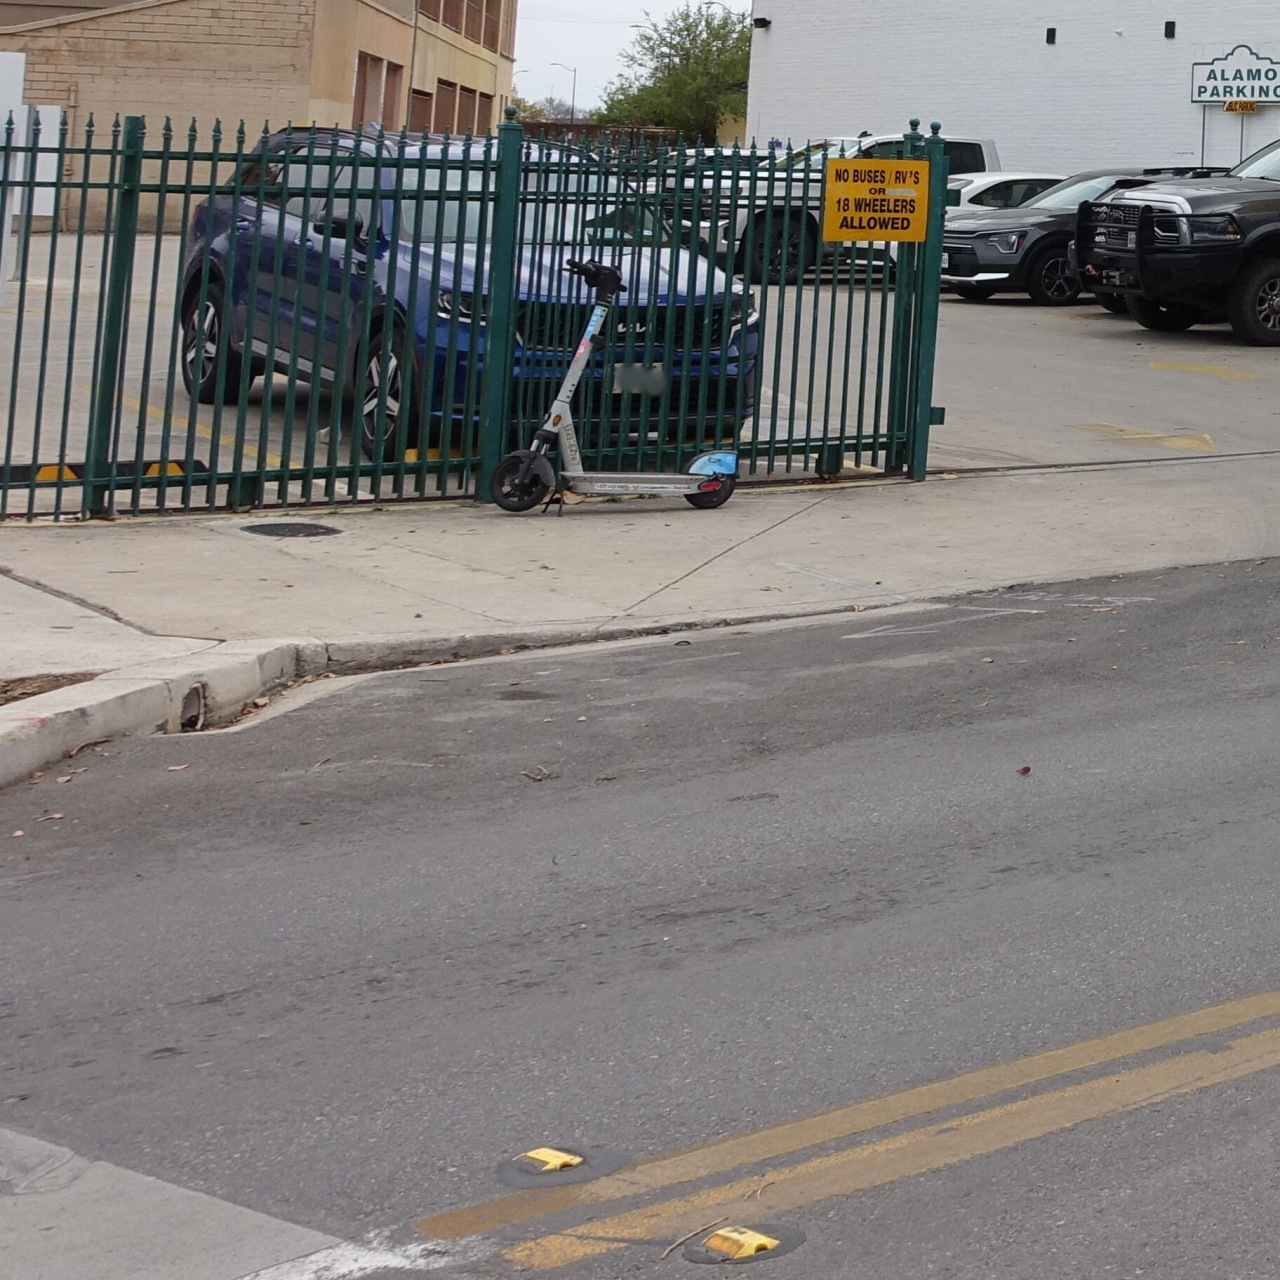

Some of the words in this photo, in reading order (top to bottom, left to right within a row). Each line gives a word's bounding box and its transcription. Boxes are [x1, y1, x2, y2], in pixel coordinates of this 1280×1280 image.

[1206, 68, 1277, 81] ALAMO
[835, 169, 850, 183] NO
[853, 170, 885, 184] BUSES
[868, 187, 886, 195] OR
[836, 198, 850, 212] 18
[854, 198, 916, 214] WHEELERS
[839, 216, 910, 230] ALLOWED
